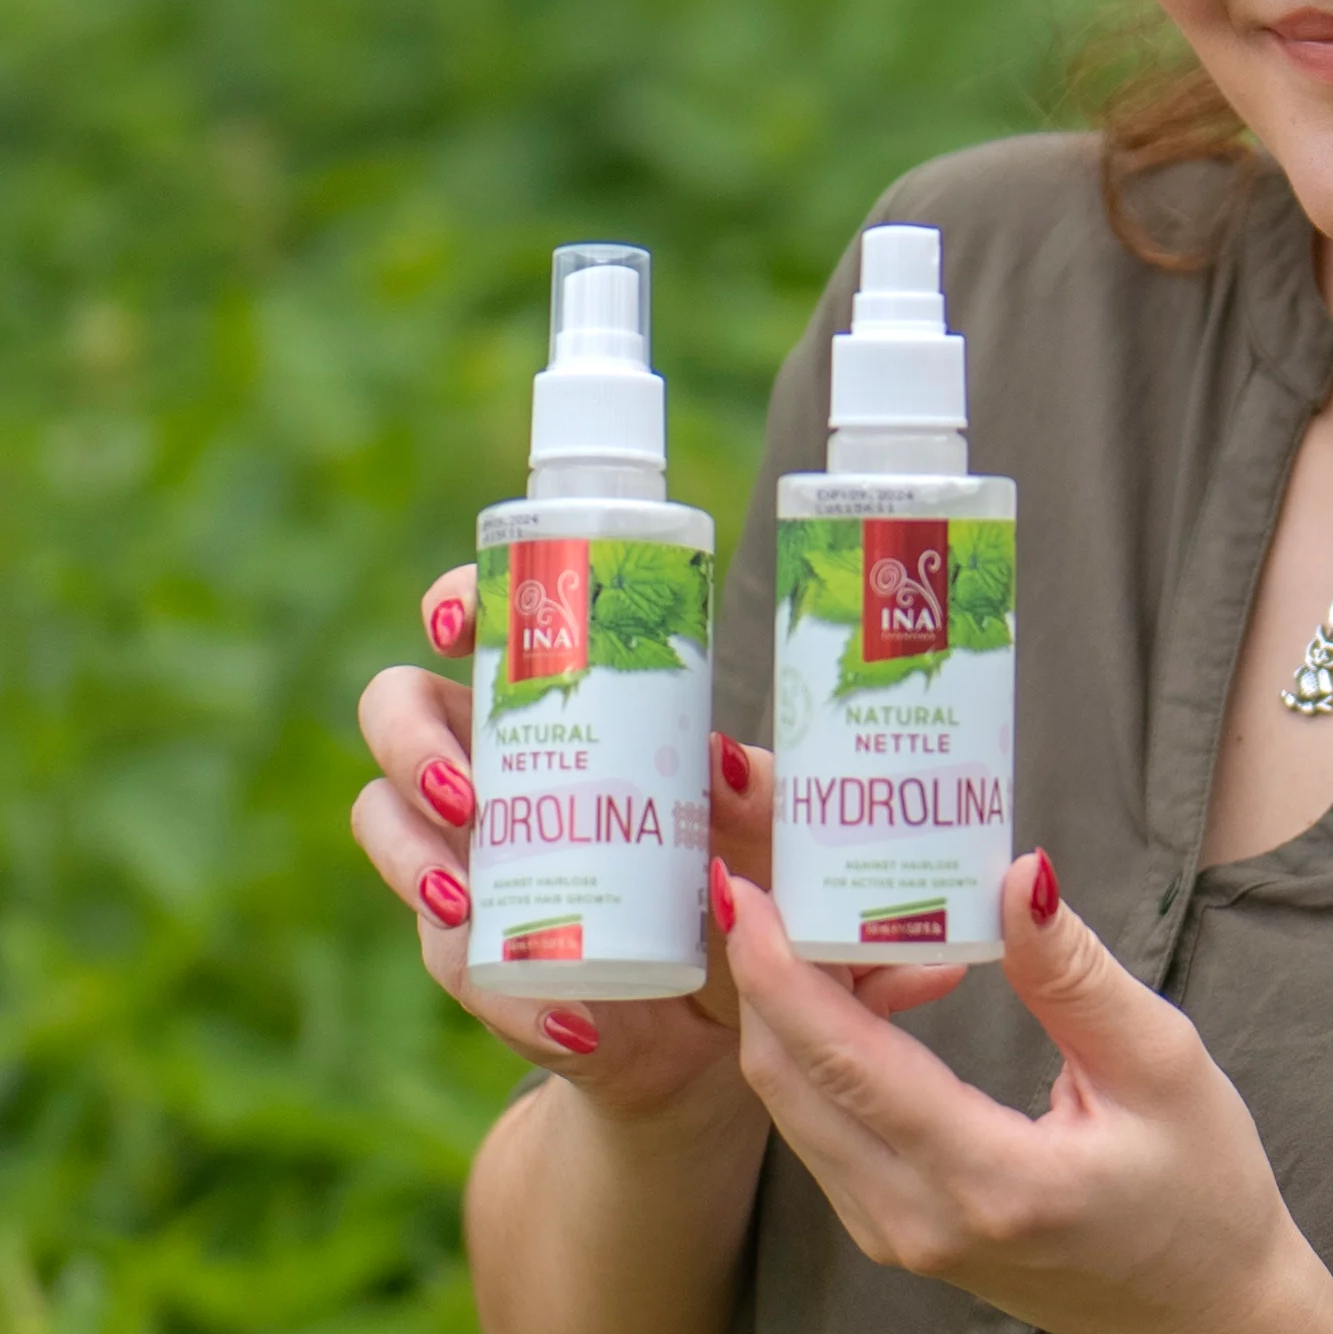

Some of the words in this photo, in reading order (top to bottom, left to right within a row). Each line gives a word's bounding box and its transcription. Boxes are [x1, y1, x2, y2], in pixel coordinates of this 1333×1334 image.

[880, 607, 936, 631] INA
[523, 627, 573, 651] INA
[845, 705, 960, 726] NATURAL
[495, 723, 600, 746] NATURAL
[854, 732, 951, 753] NETTLE
[501, 750, 589, 773] NETTLE
[792, 776, 1004, 827] HYDROLINA
[472, 794, 664, 848] YDROLINA
